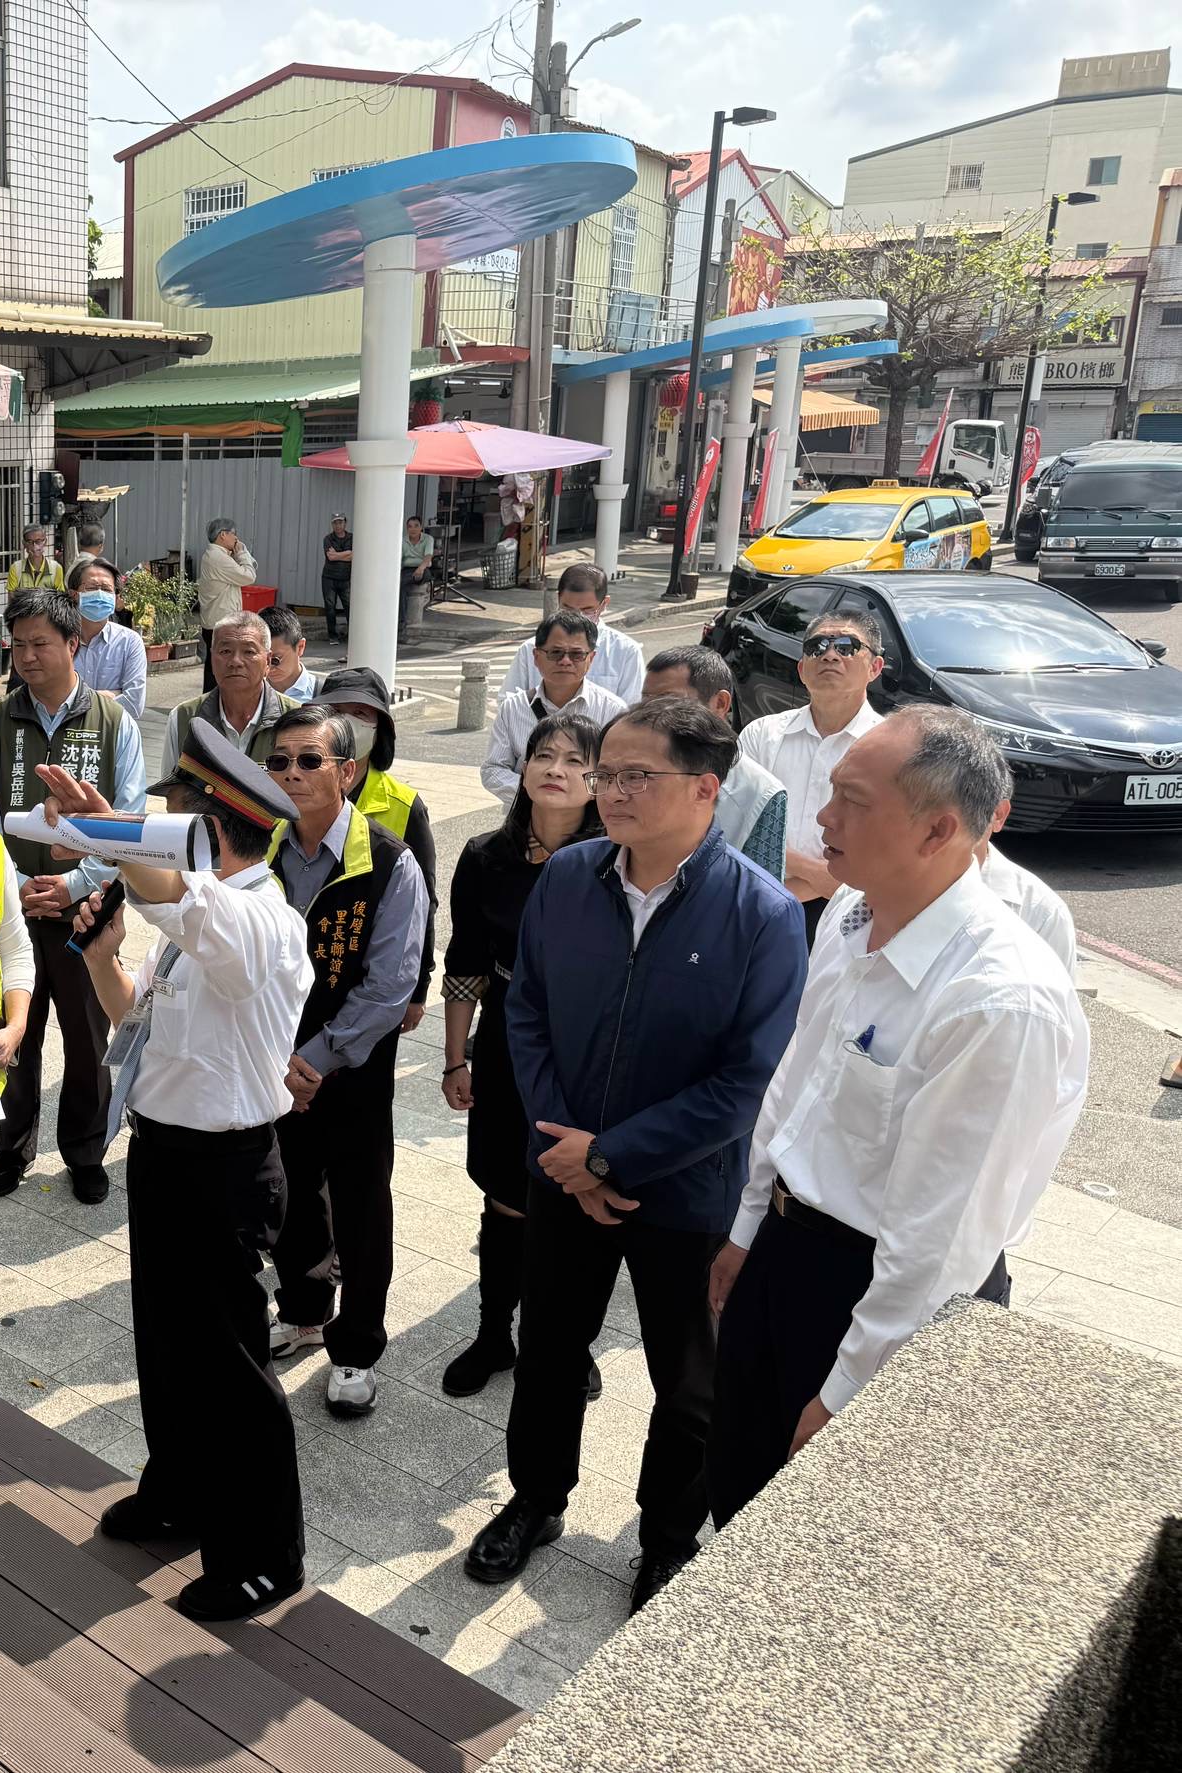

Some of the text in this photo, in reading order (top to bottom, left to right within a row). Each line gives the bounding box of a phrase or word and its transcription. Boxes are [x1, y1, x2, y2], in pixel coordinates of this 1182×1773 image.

[1008, 361, 1116, 380] 熊BRO檳榔
[10, 762, 25, 806] 吳岳庭
[80, 744, 101, 789] 林俊
[314, 916, 331, 959] 會長
[349, 900, 367, 951] 後壁區
[327, 910, 348, 989] 里長聯誼會
